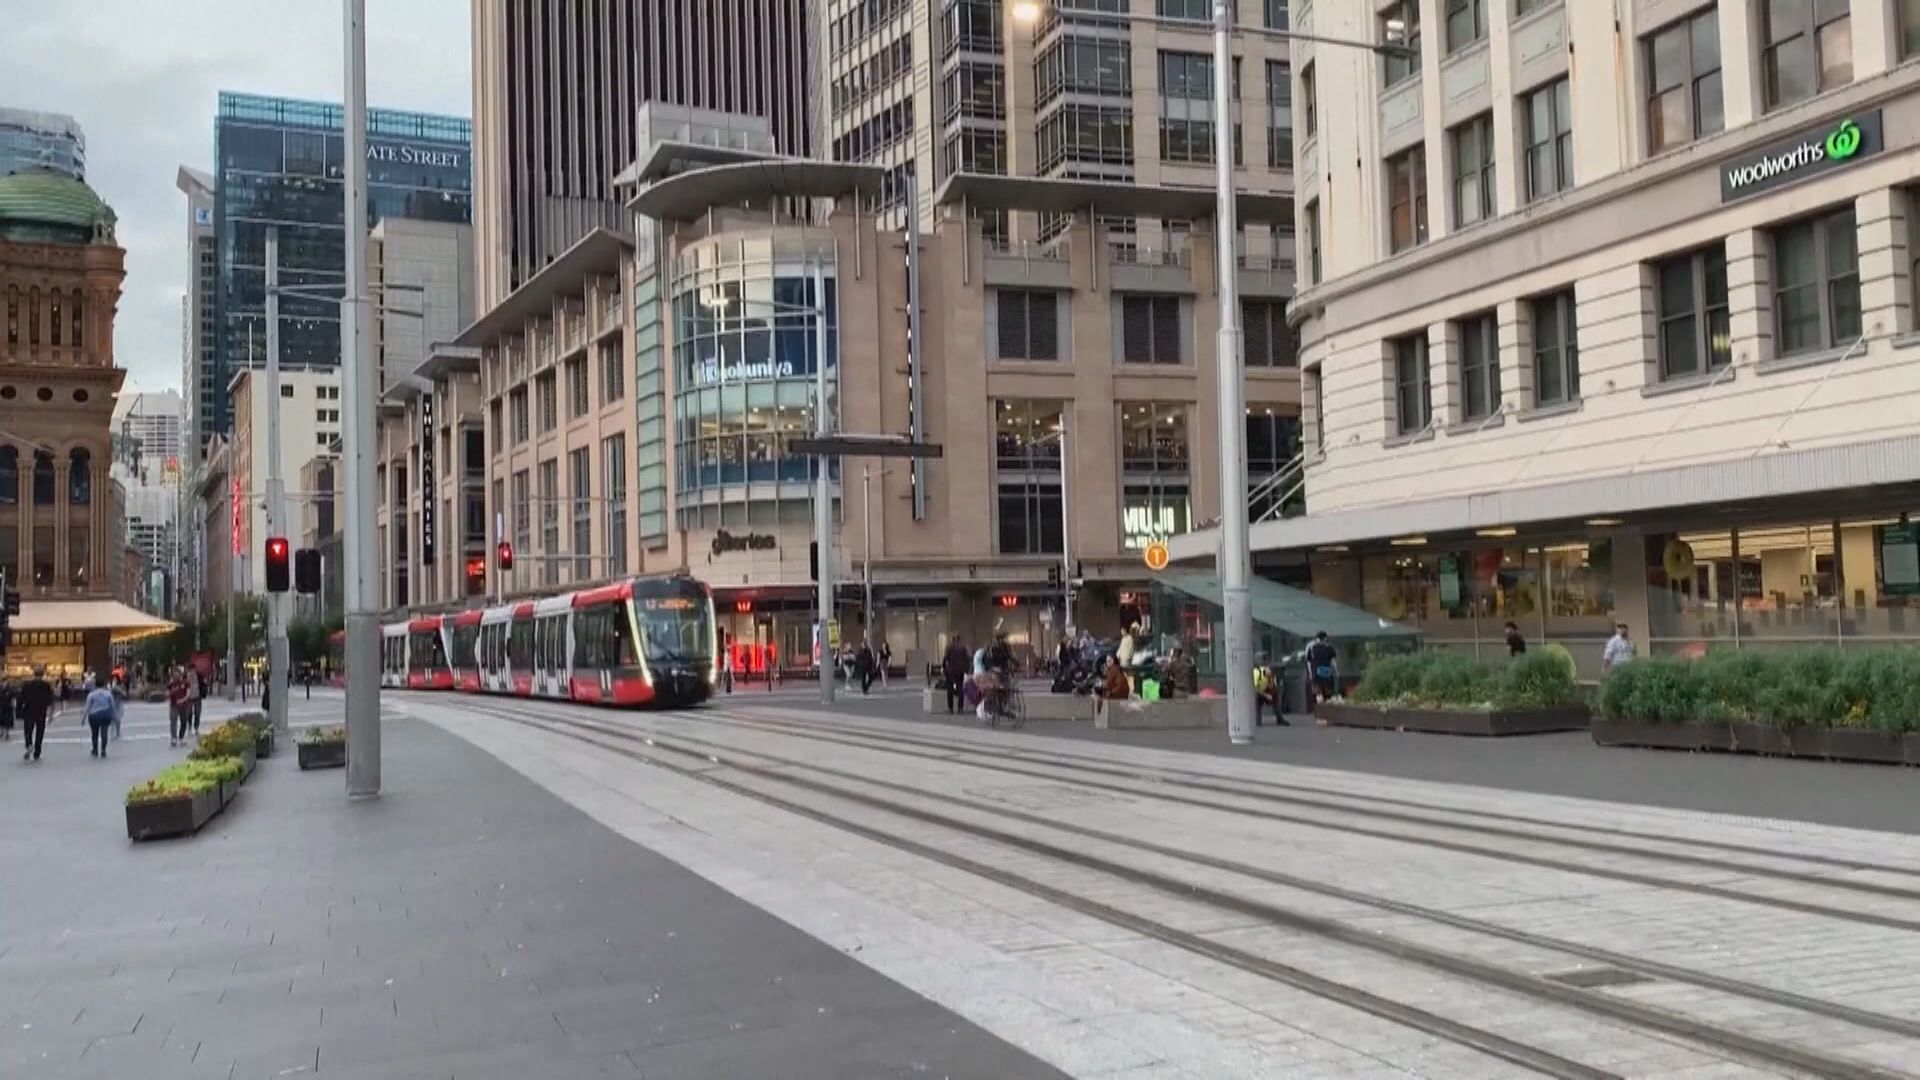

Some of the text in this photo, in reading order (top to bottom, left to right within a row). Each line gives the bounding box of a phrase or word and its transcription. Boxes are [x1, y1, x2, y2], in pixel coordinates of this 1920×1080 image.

[401, 145, 461, 168] STREET
[1728, 141, 1824, 189] Woolworths
[1123, 506, 1175, 534] MUJI
